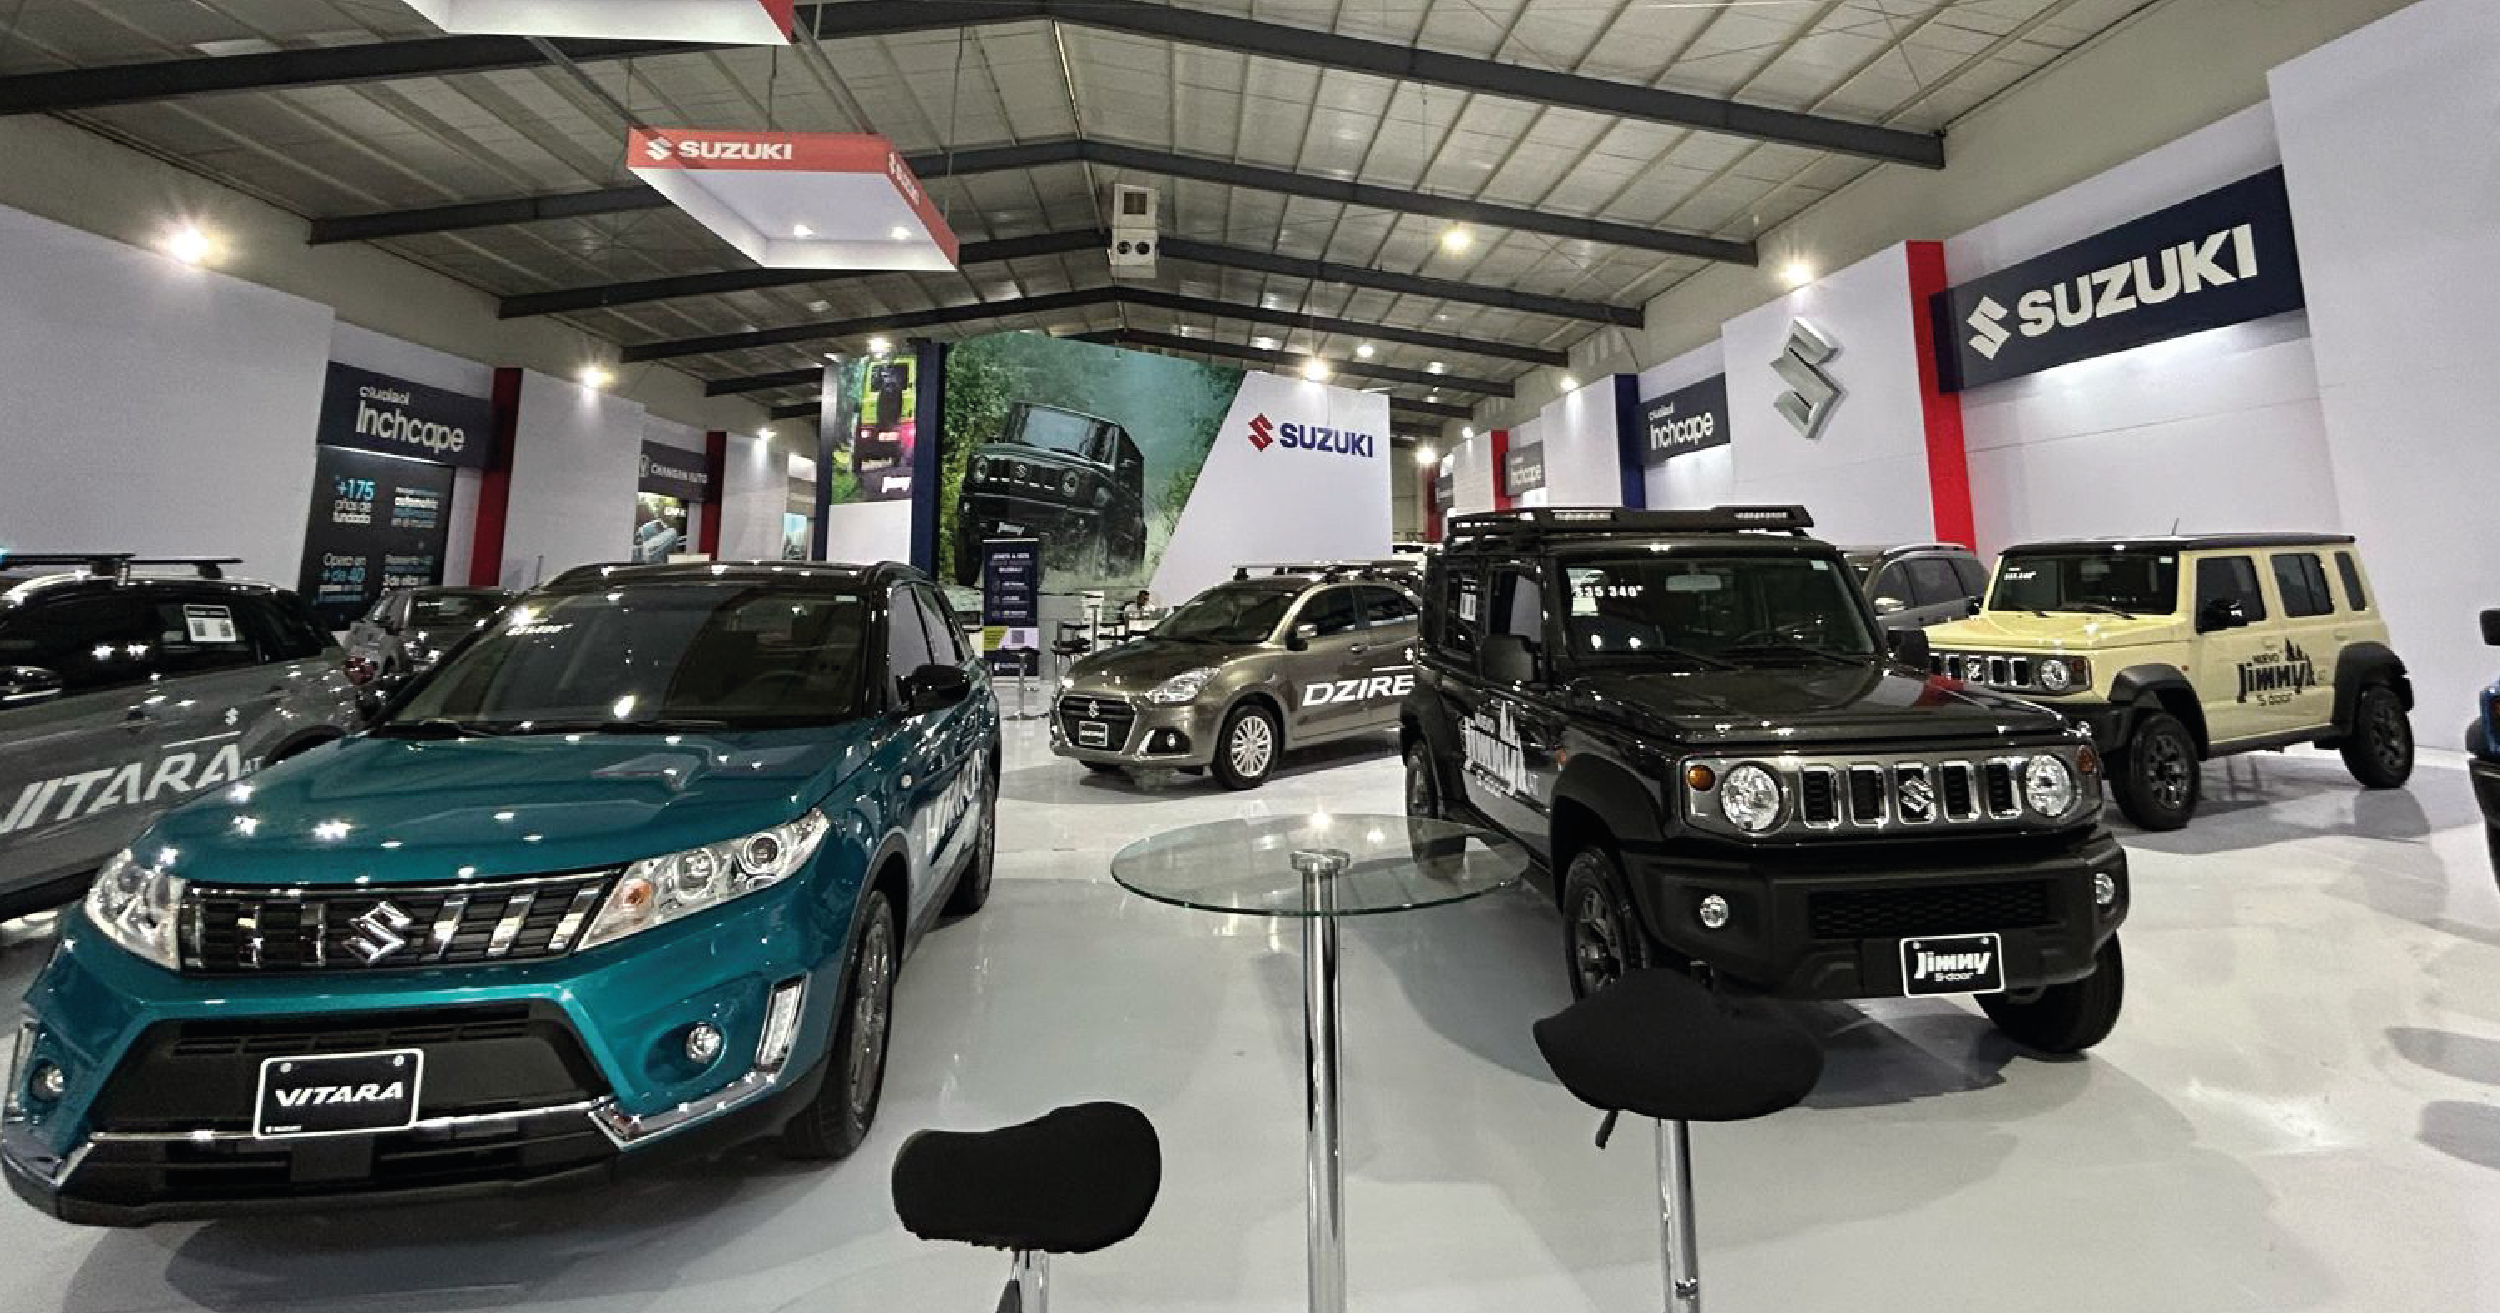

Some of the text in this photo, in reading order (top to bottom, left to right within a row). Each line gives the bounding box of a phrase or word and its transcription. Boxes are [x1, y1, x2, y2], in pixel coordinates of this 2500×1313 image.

[678, 139, 792, 160] SUZUKI
[2018, 223, 2258, 338] SUZUKI
[355, 399, 465, 455] Inchcape
[1279, 422, 1374, 458] SUZUKI
[1650, 412, 1714, 451] Inchcape
[1302, 674, 1416, 707] DZIRE
[1914, 951, 1991, 979] Jimny
[275, 1081, 404, 1107] VITARA
